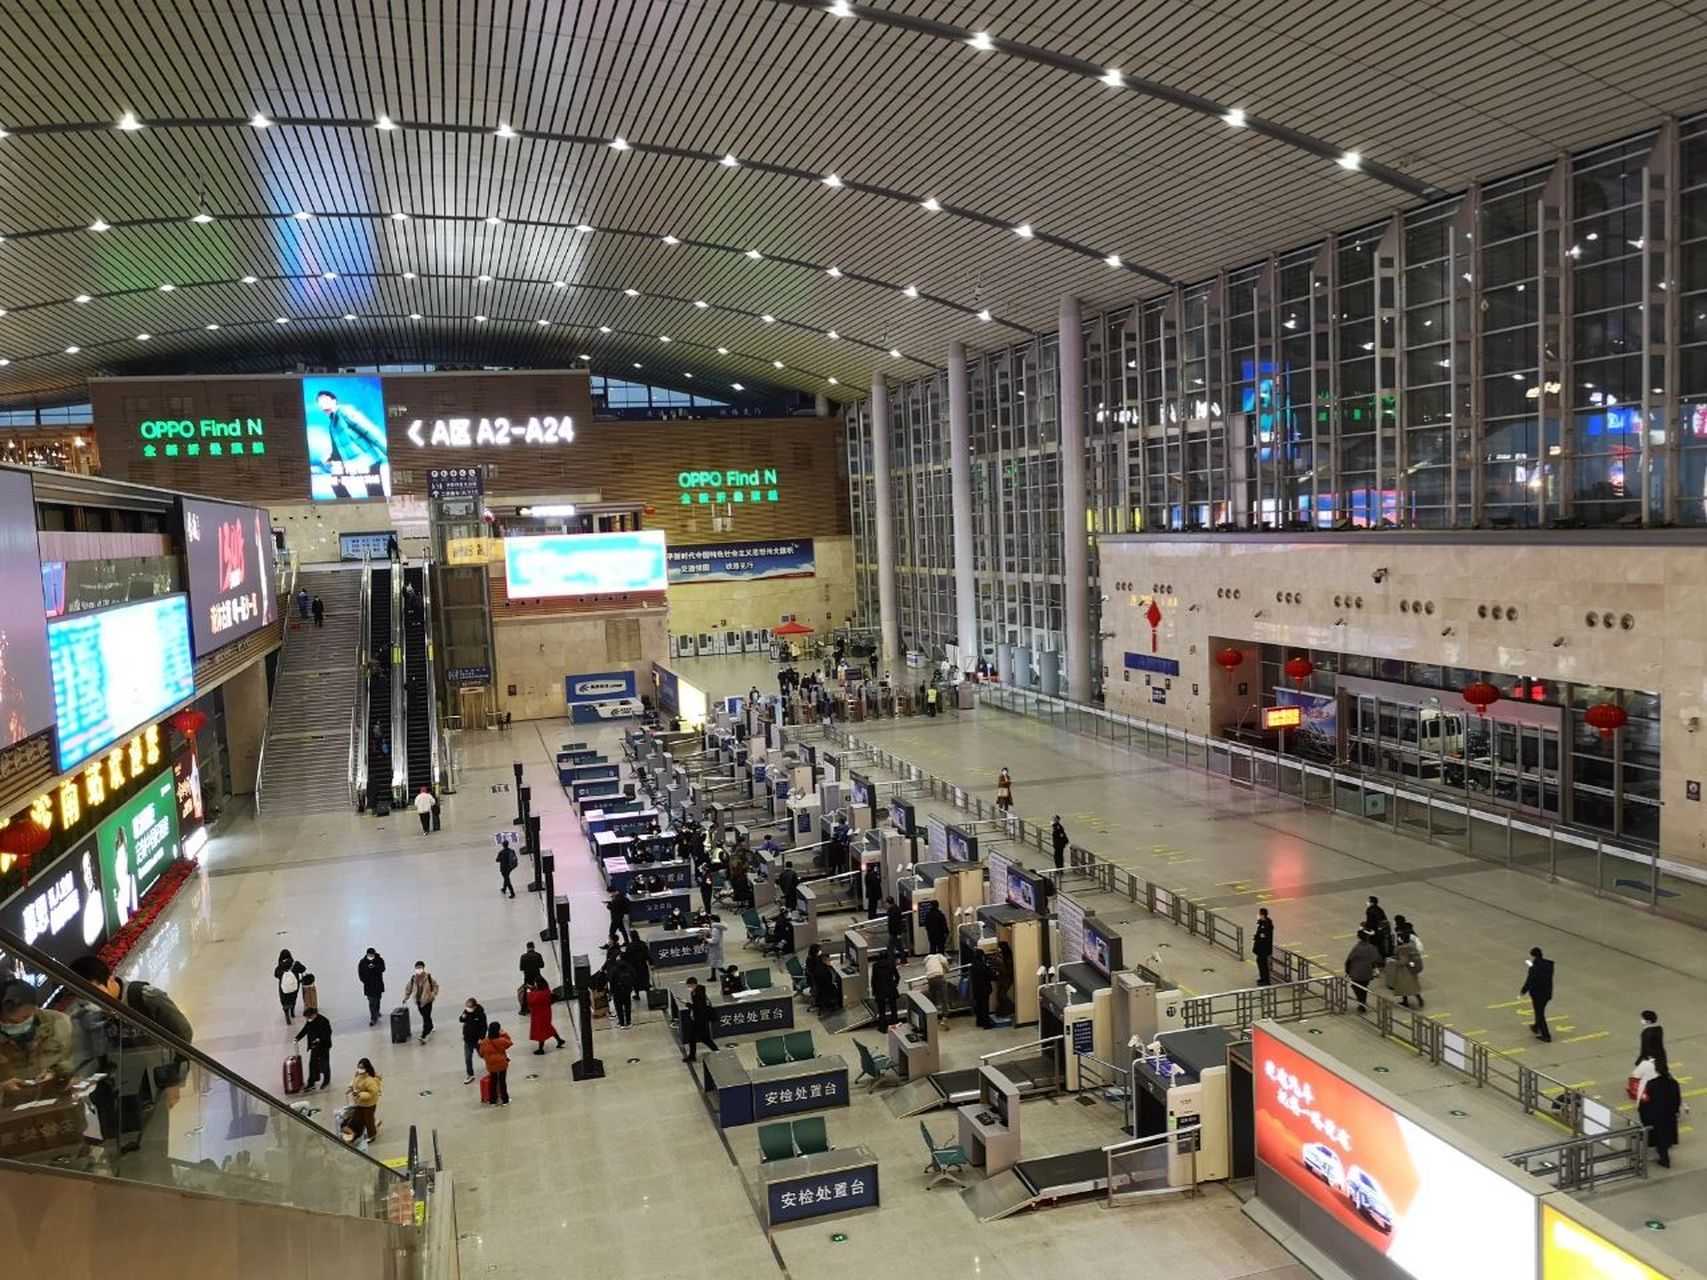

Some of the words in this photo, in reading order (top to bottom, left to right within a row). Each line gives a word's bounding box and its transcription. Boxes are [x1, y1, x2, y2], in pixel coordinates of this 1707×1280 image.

[140, 419, 195, 439] OPPO
[199, 418, 241, 437] Find
[246, 417, 263, 436] N
[430, 418, 472, 446] A区
[476, 415, 575, 445] A2-A24
[678, 470, 722, 488] OPPO
[726, 469, 760, 487] Find
[764, 468, 777, 485] N
[719, 1007, 784, 1027] 安检处置台
[764, 1081, 837, 1106] 安检处置台
[780, 1179, 866, 1209] 安检处置台
